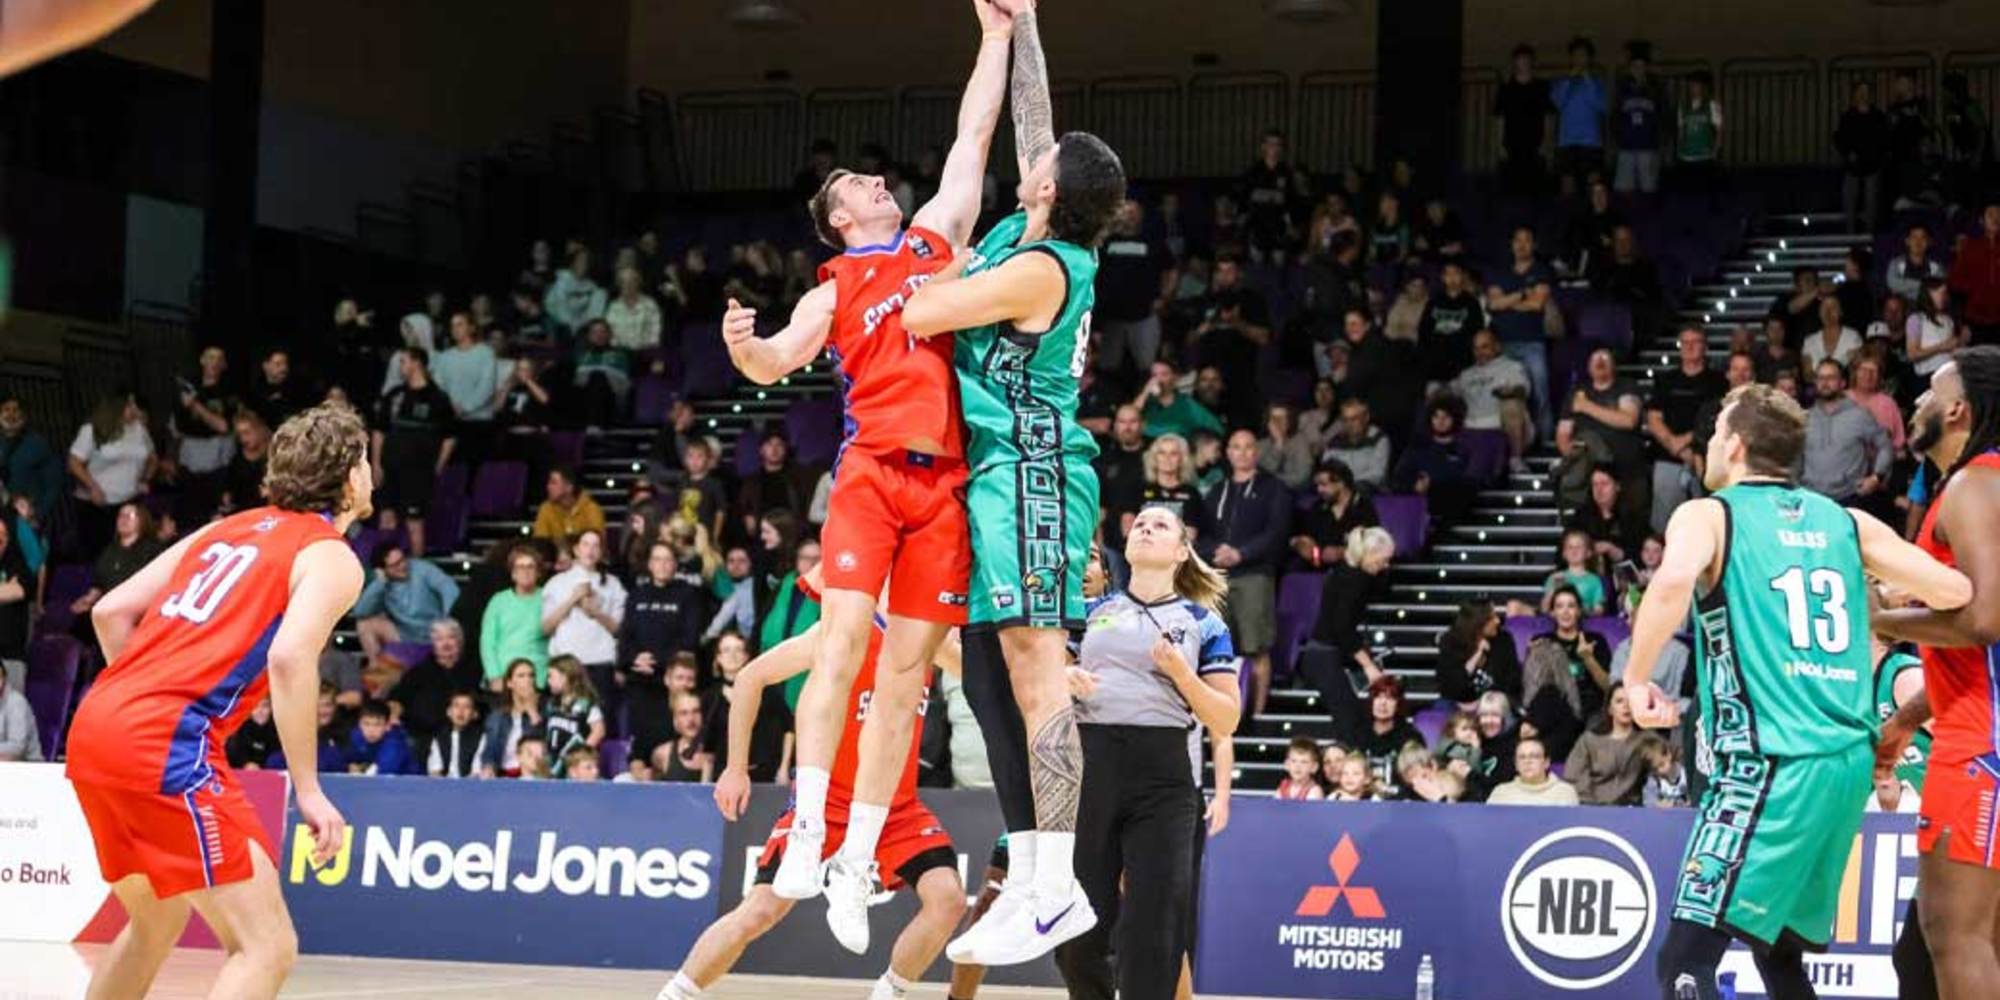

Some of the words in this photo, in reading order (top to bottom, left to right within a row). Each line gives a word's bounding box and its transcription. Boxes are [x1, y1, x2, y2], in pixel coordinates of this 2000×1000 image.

[160, 541, 259, 624] 30
[1769, 565, 1850, 654] 13
[20, 862, 71, 885] Bank
[361, 826, 512, 892] Noel
[513, 832, 712, 899] Jones
[1537, 878, 1618, 936] NBL
[1278, 925, 1402, 949] MITSUBISHI
[1294, 948, 1385, 971] MOTORS
